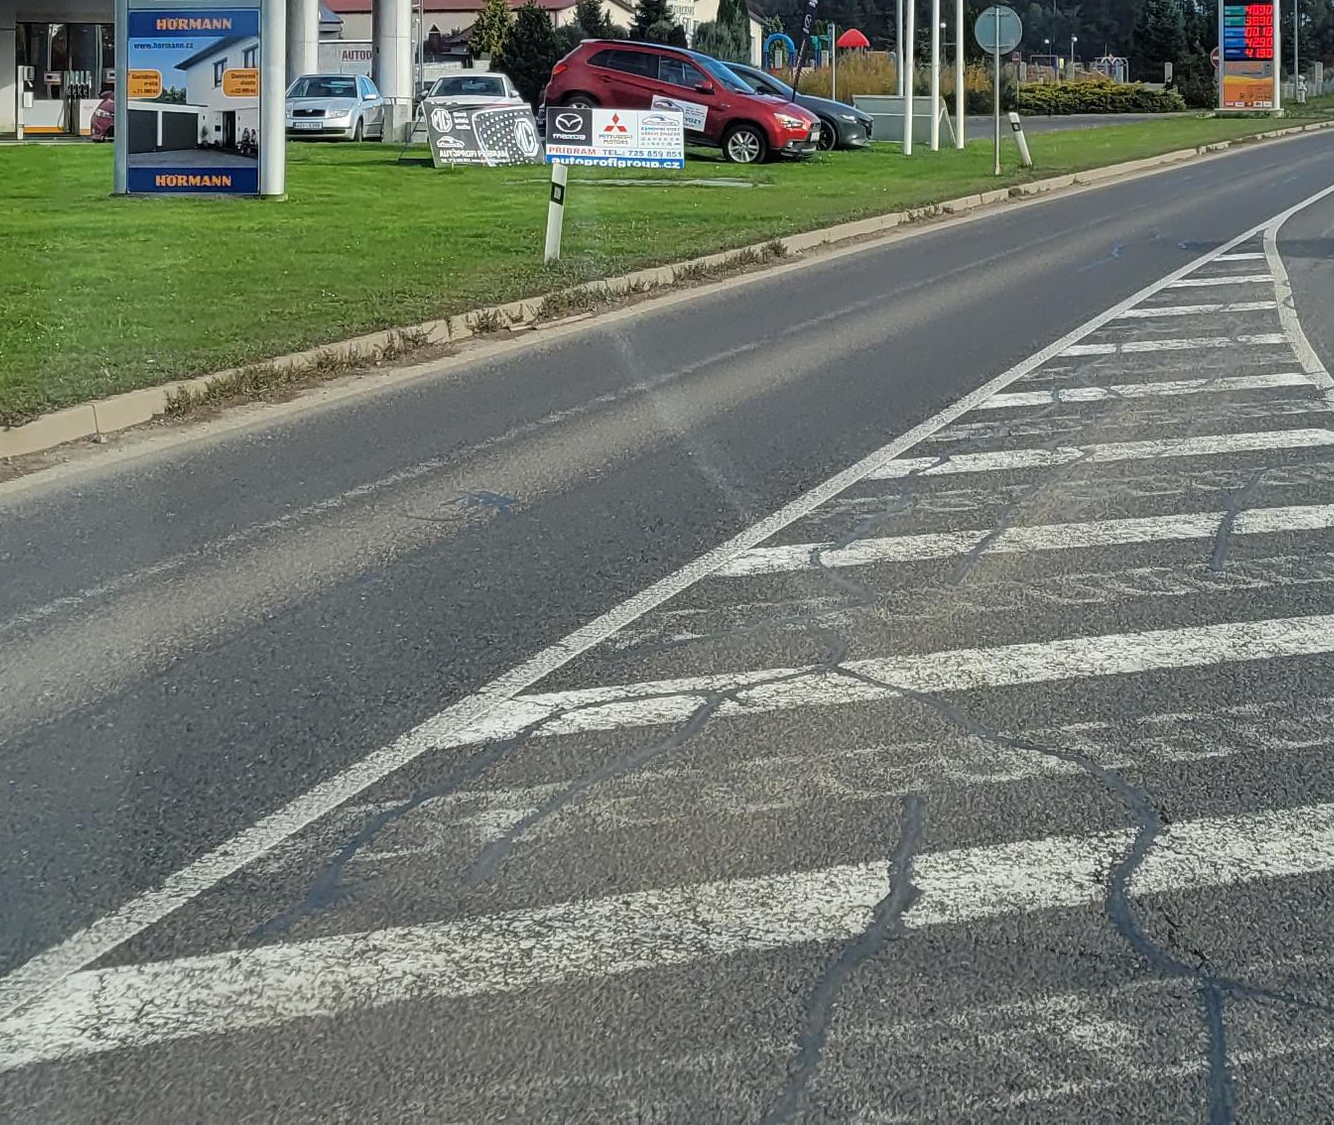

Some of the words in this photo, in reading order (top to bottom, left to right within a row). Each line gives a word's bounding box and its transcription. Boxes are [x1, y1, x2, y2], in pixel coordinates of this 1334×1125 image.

[156, 17, 233, 31] HÖRMANN
[432, 111, 452, 130] MG
[552, 133, 587, 141] mazda
[551, 156, 682, 169] autoprofigroup.cz
[155, 174, 232, 187] HÖRMANN
